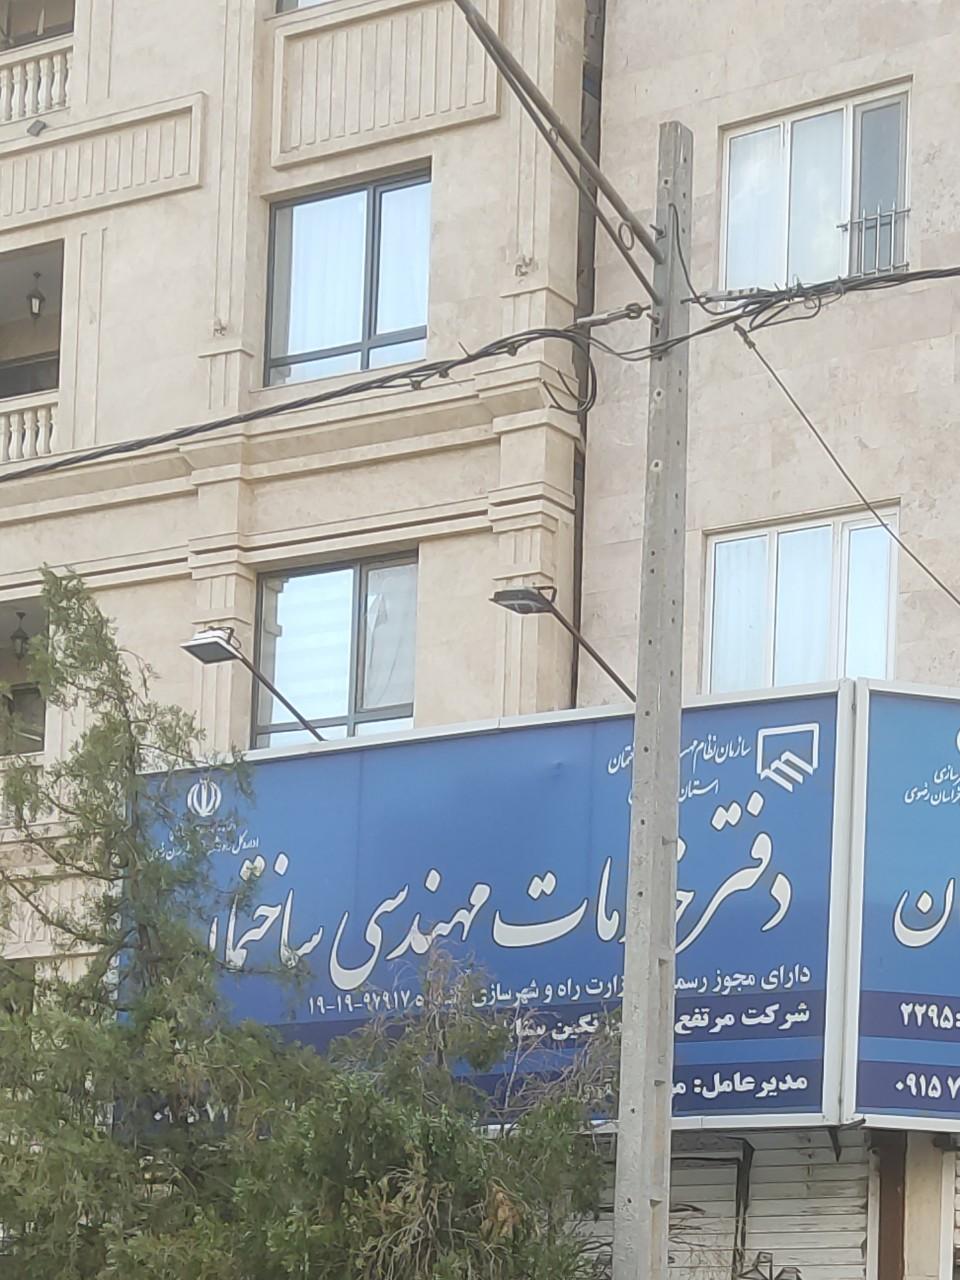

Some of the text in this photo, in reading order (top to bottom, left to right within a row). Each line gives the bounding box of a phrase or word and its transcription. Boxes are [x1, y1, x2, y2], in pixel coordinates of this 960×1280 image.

[675, 791, 792, 955] دفتر
[329, 868, 491, 991] مهندسی
[558, 978, 581, 1000] راه
[585, 974, 625, 998] زارت
[674, 975, 707, 993] رسم
[712, 968, 755, 995] مجوز
[760, 964, 811, 990] دارای
[544, 985, 552, 1003] و
[674, 1007, 735, 1034] مرتفع
[741, 1002, 810, 1030] شرکت
[755, 1073, 808, 1098] مدیر
[896, 1072, 942, 1098] ۰۹۱۵
